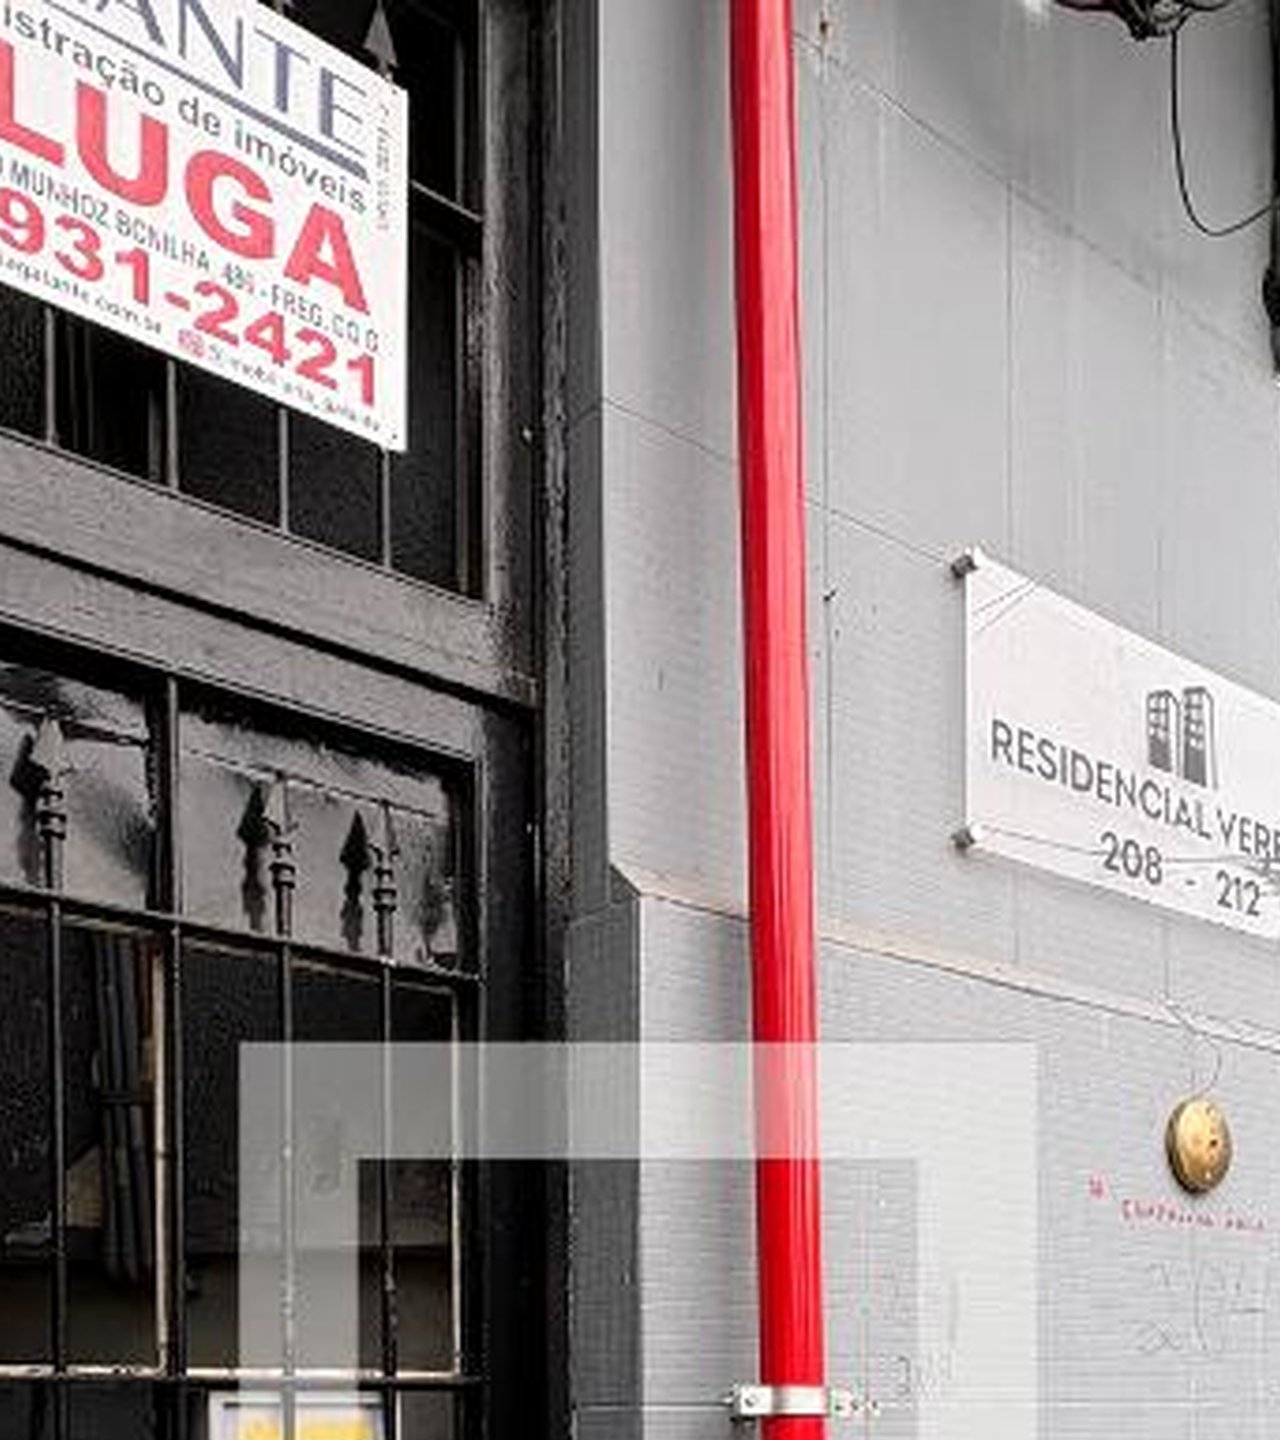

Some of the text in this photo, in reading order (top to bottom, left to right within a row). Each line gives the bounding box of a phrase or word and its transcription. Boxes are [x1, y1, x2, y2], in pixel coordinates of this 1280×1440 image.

[178, 96, 221, 137] de
[235, 119, 367, 215] imóveis
[991, 719, 1212, 839] RESIDENCIAL
[1099, 831, 1163, 886] 208
[1216, 869, 1262, 917] 212
